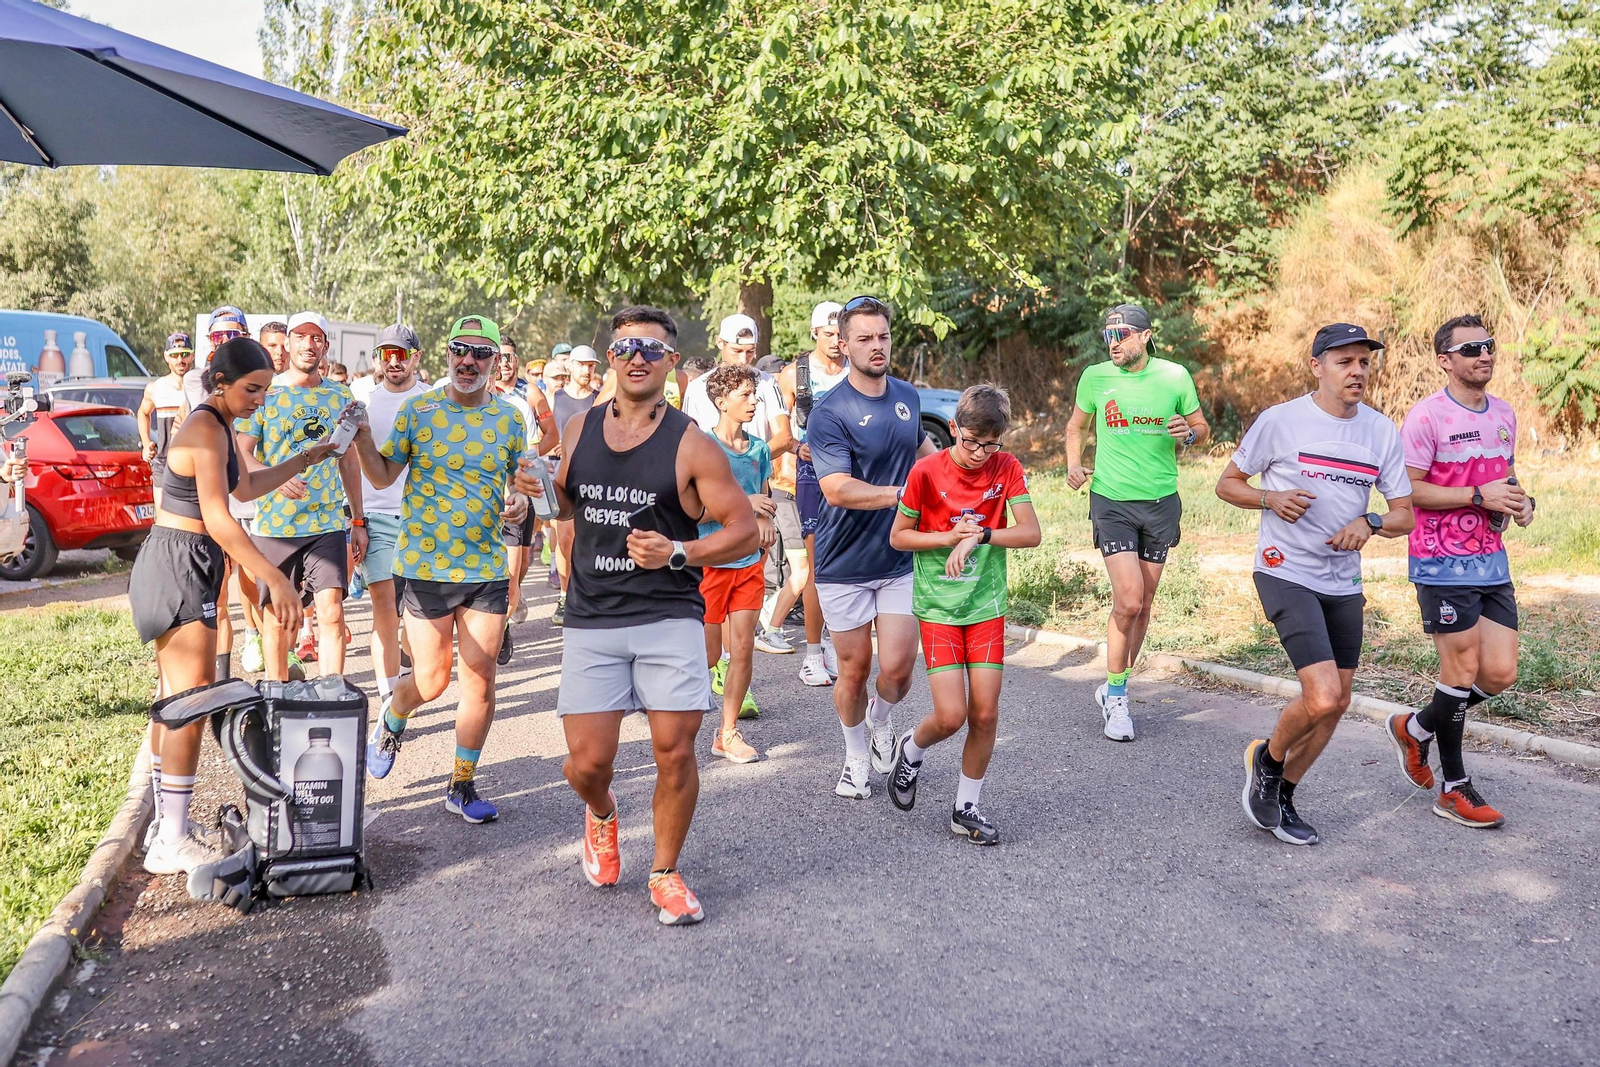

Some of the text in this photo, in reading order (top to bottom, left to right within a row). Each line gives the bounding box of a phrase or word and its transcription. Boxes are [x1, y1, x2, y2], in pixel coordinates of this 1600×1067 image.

[3, 335, 16, 347] LO
[1126, 406, 1153, 416] RUN
[1132, 416, 1164, 426] ROME
[1449, 430, 1480, 442] IMPARABLES
[579, 484, 657, 506] POR LOS QUE
[594, 554, 635, 572] NONO
[294, 781, 328, 790] VITAMIN
[294, 789, 314, 798] WELL
[294, 795, 334, 805] SPORT 001
